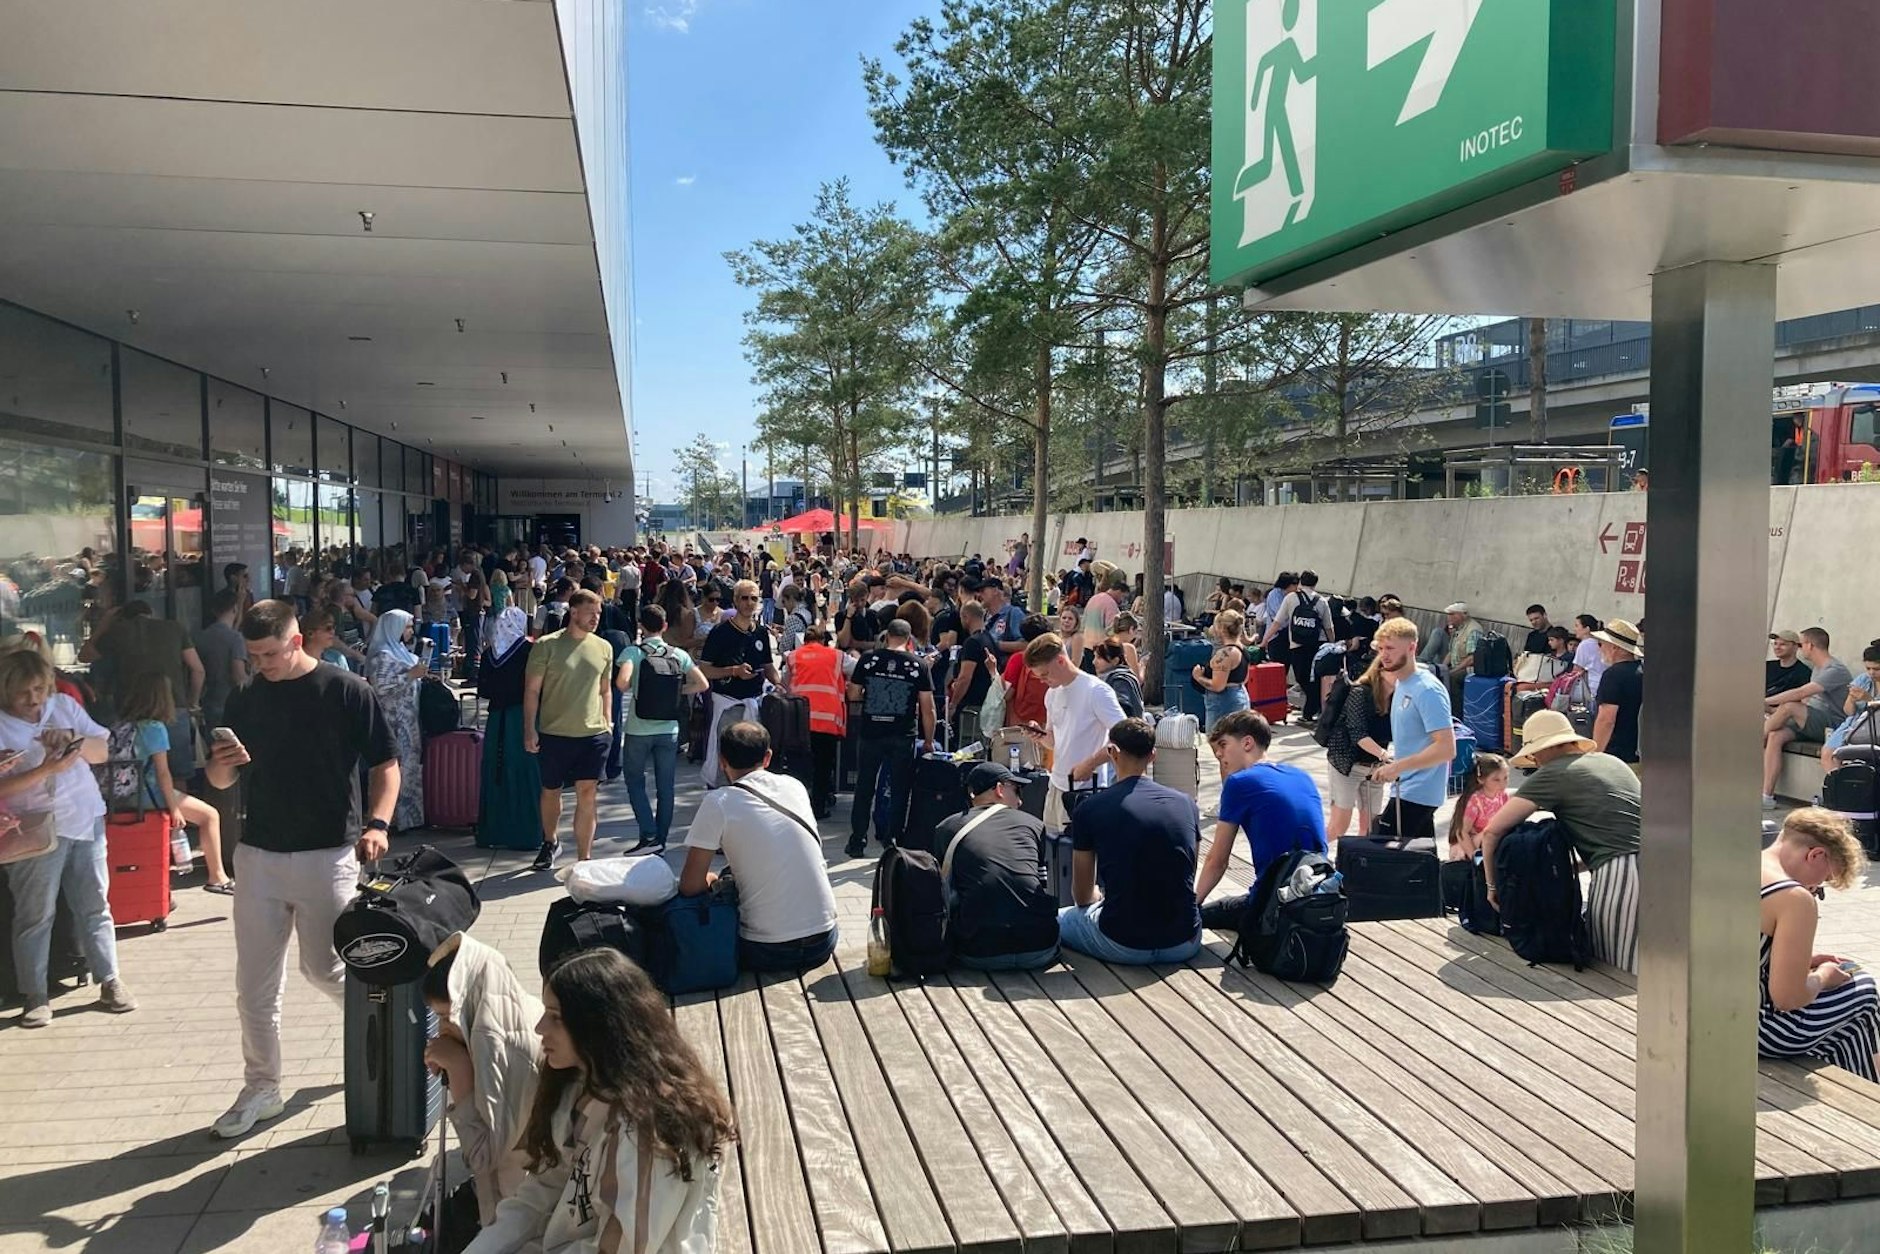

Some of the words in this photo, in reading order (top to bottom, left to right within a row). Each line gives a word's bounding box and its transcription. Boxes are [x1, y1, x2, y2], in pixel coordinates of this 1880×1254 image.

[1460, 115, 1523, 163] INOTEC
[510, 489, 563, 498] Willkommen
[1768, 527, 1783, 537] us
[1293, 615, 1316, 628] VANS
